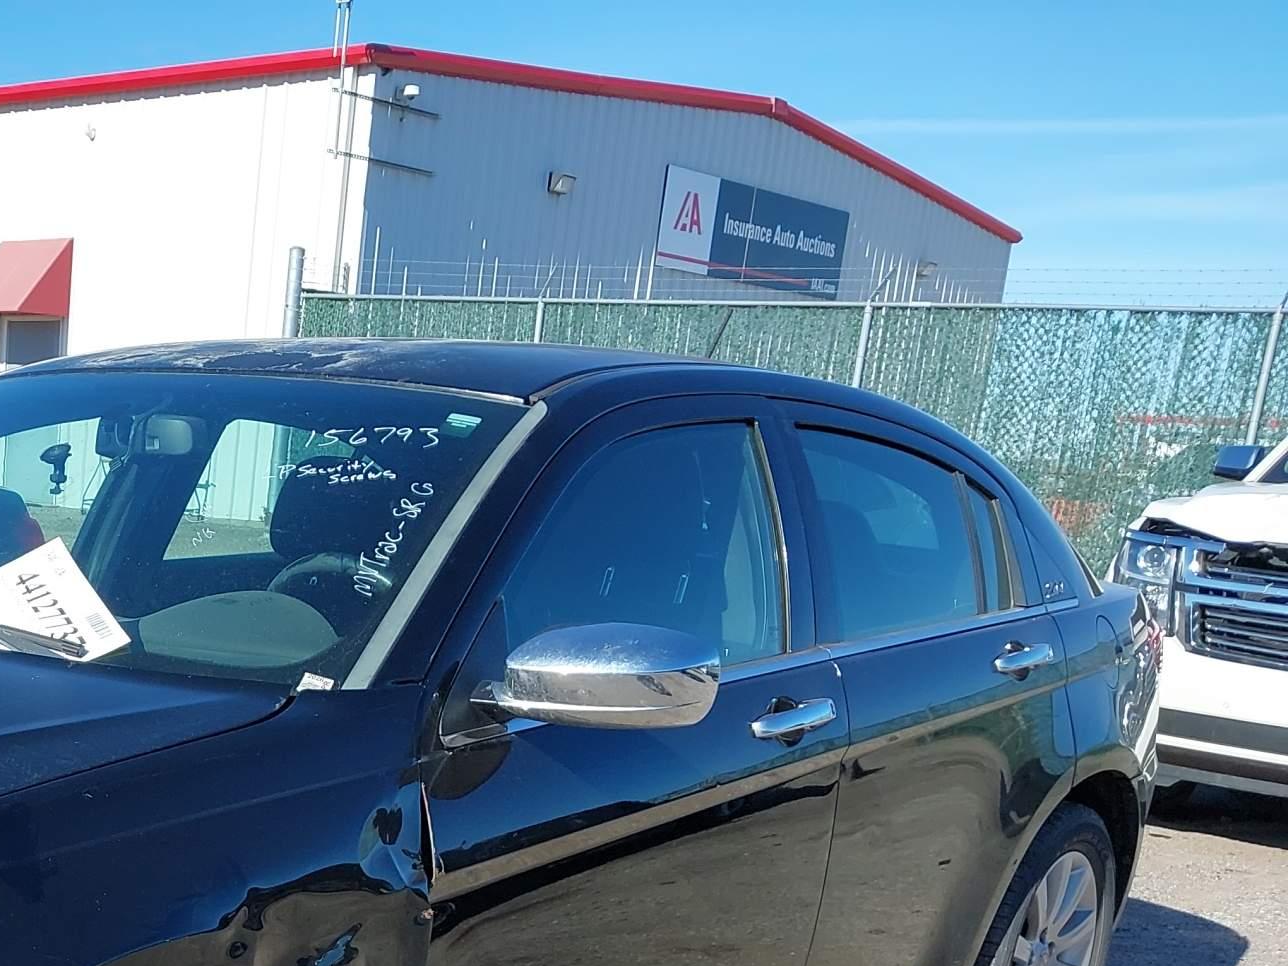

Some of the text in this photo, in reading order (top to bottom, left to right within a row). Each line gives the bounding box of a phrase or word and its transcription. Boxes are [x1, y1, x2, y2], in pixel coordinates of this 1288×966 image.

[723, 212, 836, 258] Insurance Auto Auctions
[305, 427, 440, 449] 156793
